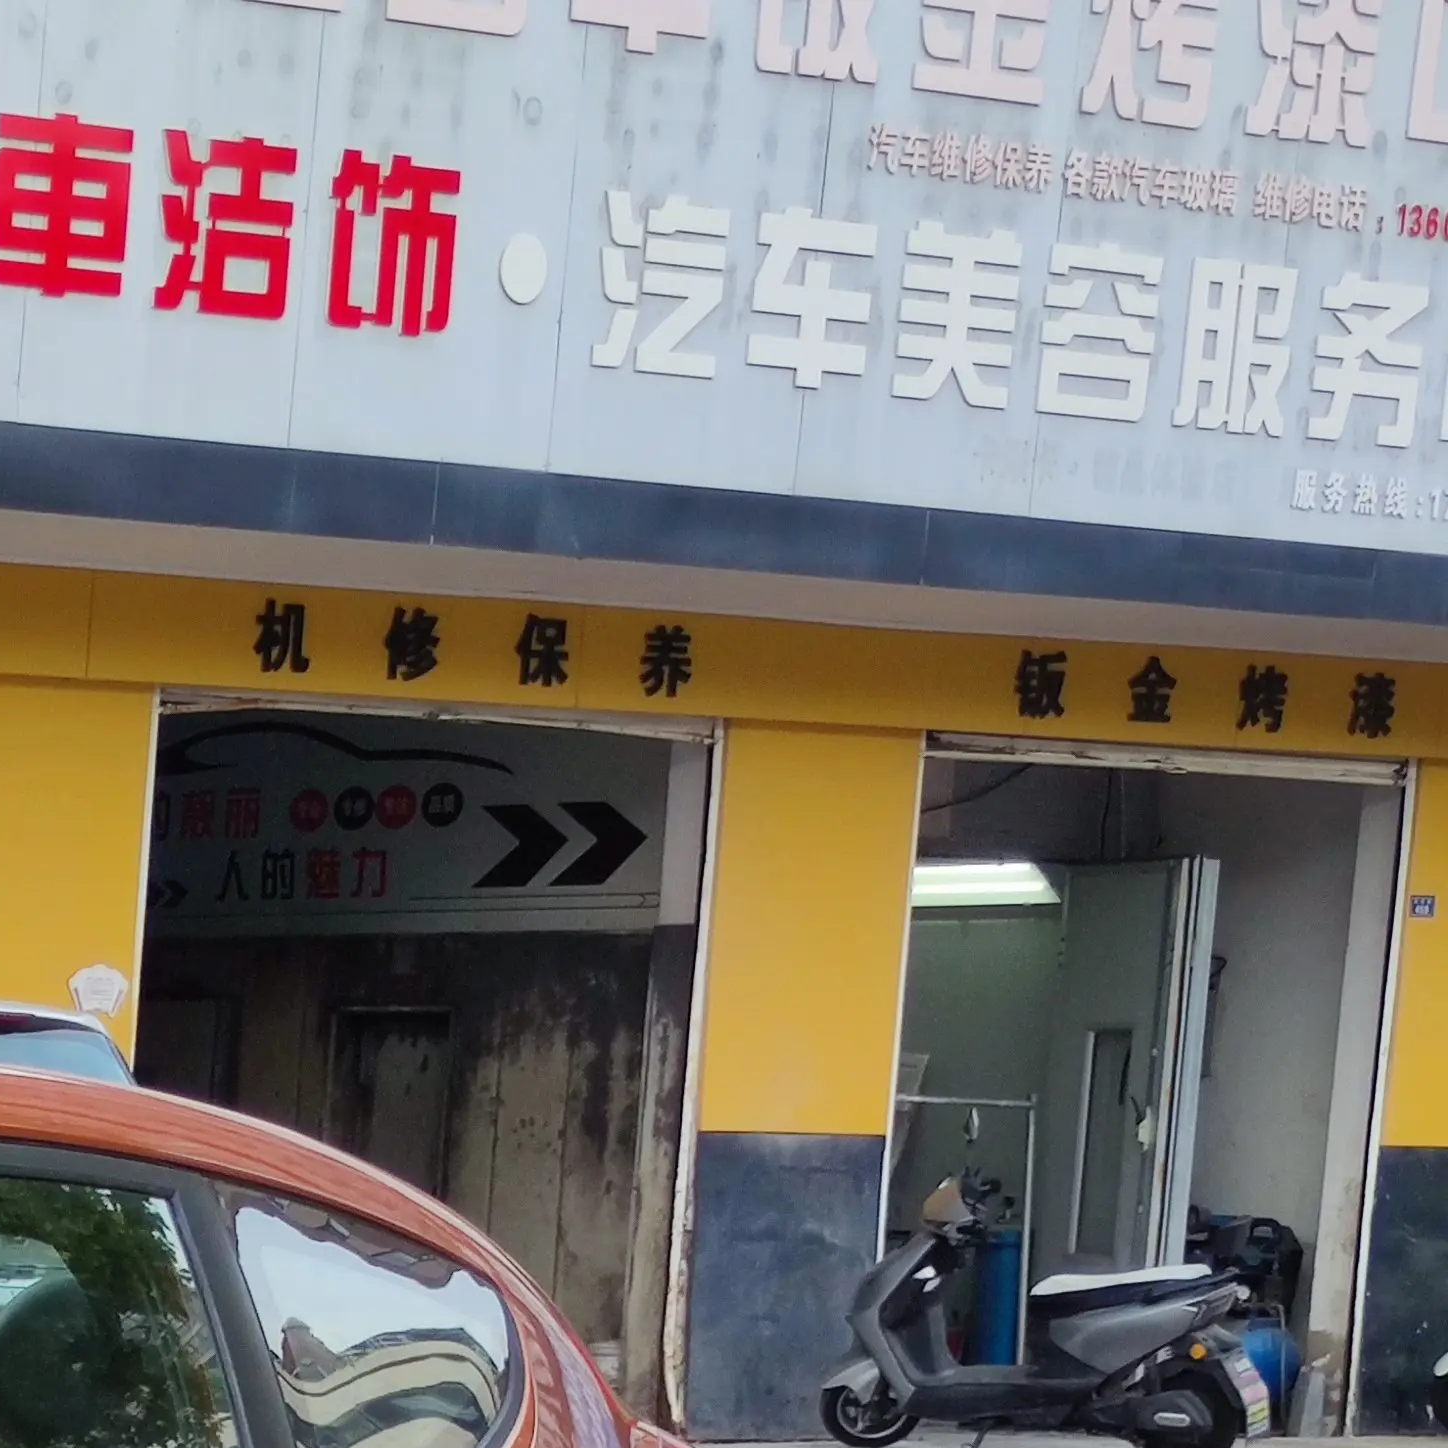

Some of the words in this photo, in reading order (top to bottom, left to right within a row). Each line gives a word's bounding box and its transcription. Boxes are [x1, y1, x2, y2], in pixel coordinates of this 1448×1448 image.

[866, 122, 1054, 195] 汽车维修保养
[1062, 148, 1241, 216] 各款汽车玻璃
[591, 188, 1448, 450] 汽车美容服务
[253, 598, 692, 698] 机修保养
[1014, 649, 1398, 738] 钣金烤漆
